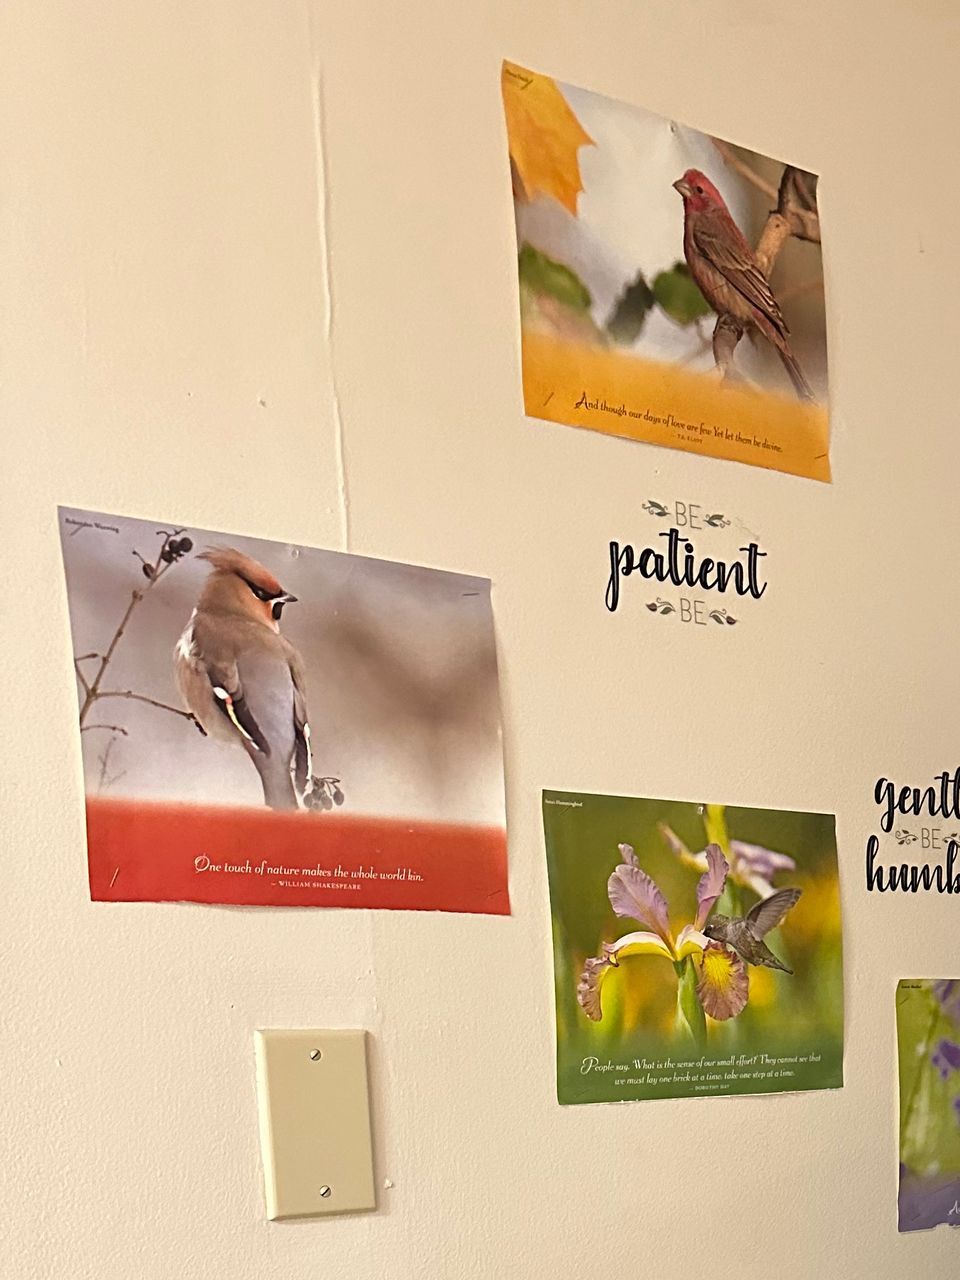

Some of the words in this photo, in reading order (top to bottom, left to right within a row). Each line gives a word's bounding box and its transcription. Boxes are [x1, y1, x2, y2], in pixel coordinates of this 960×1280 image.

[575, 392, 598, 410] And
[600, 400, 627, 416] though
[628, 410, 642, 419] our
[644, 408, 660, 424] days
[662, 414, 674, 428] of
[671, 416, 686, 430] love
[686, 424, 698, 432] are
[725, 428, 734, 440] let
[675, 501, 702, 529] BE
[605, 528, 767, 612] patient
[680, 598, 707, 626] BE
[921, 828, 942, 850] BE
[194, 852, 222, 874] One
[224, 860, 252, 874] touch
[254, 860, 268, 876] of
[267, 865, 300, 875] nature
[302, 864, 332, 876] makes
[334, 864, 348, 878] the
[350, 866, 378, 879] whole
[380, 868, 406, 880] world
[407, 868, 424, 882] kin.
[278, 880, 310, 888] WILLIAM
[312, 882, 361, 890] SHAKESPEARE
[580, 1056, 614, 1075] People
[664, 1058, 676, 1069] the
[677, 1060, 694, 1068] sense
[696, 1056, 705, 1068] of
[626, 1076, 645, 1085] must
[673, 1072, 690, 1082] brick
[724, 1069, 738, 1080] take
[752, 1070, 766, 1080] step
